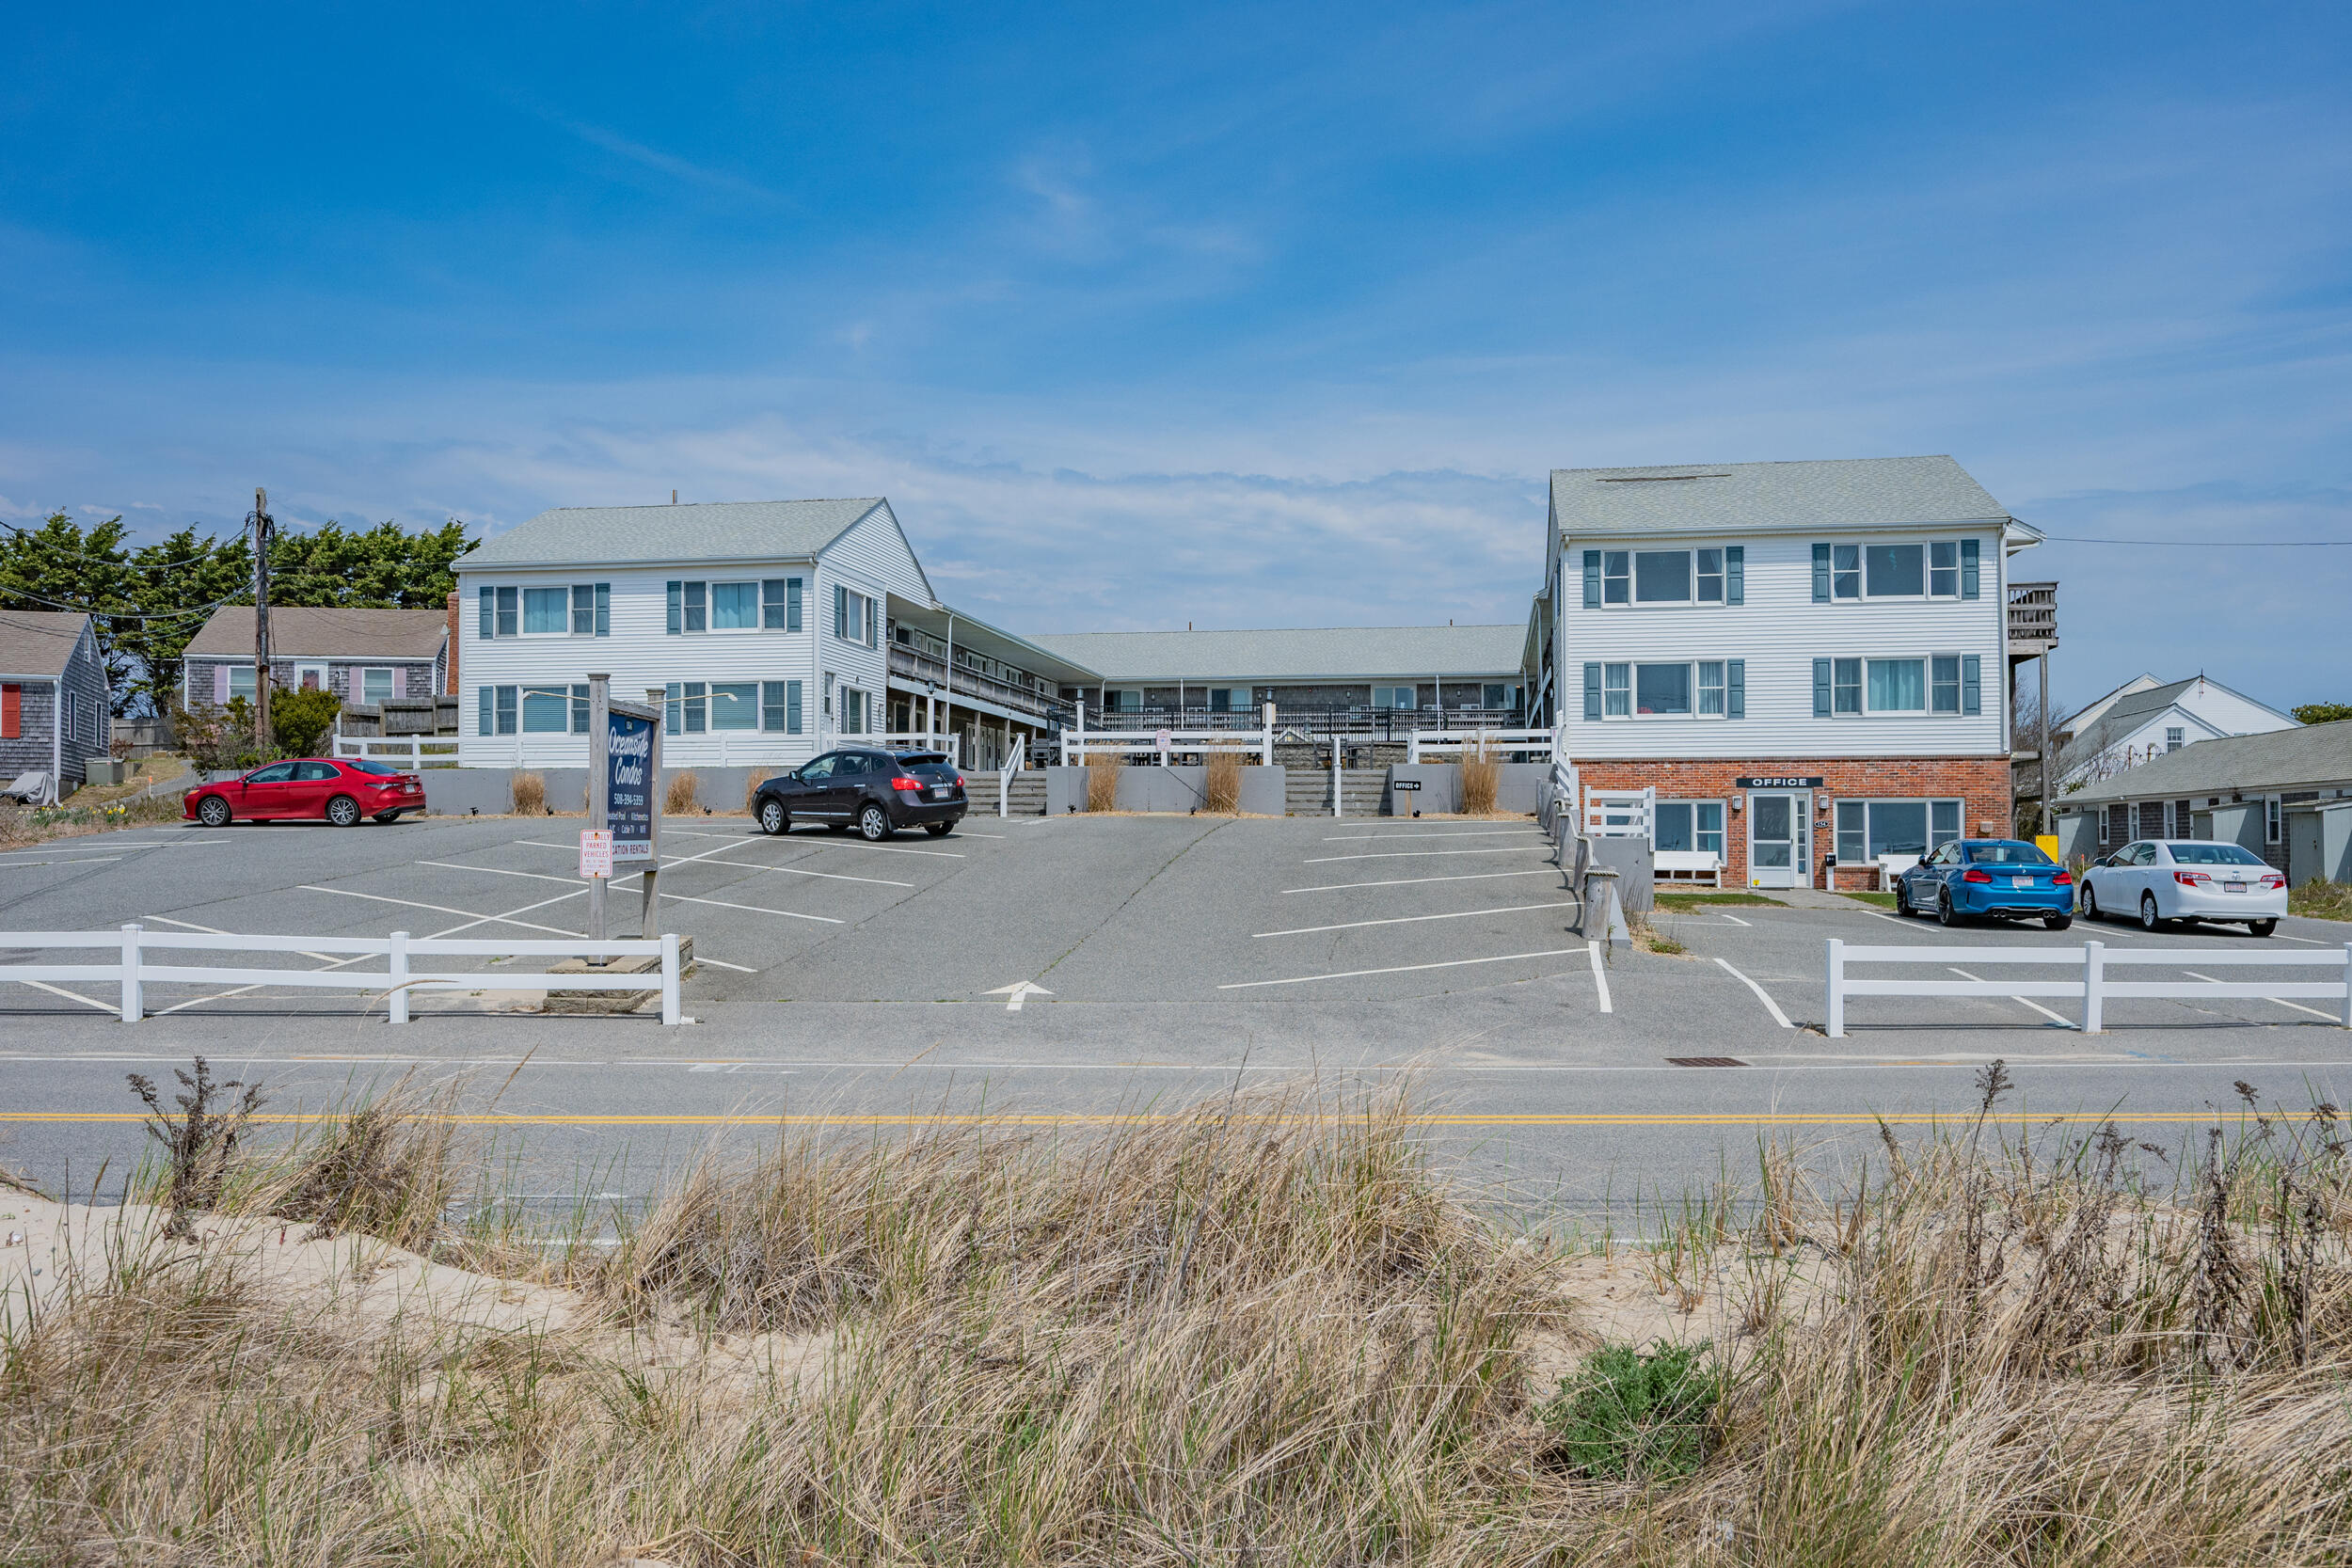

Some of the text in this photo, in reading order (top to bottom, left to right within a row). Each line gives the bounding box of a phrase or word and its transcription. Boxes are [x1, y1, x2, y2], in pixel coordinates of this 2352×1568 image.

[609, 726, 649, 758] Oceanside
[615, 757, 643, 785] Condos
[1753, 778, 1807, 786] OFFICE
[608, 811, 618, 821] eated
[629, 844, 649, 855] RENTALS
